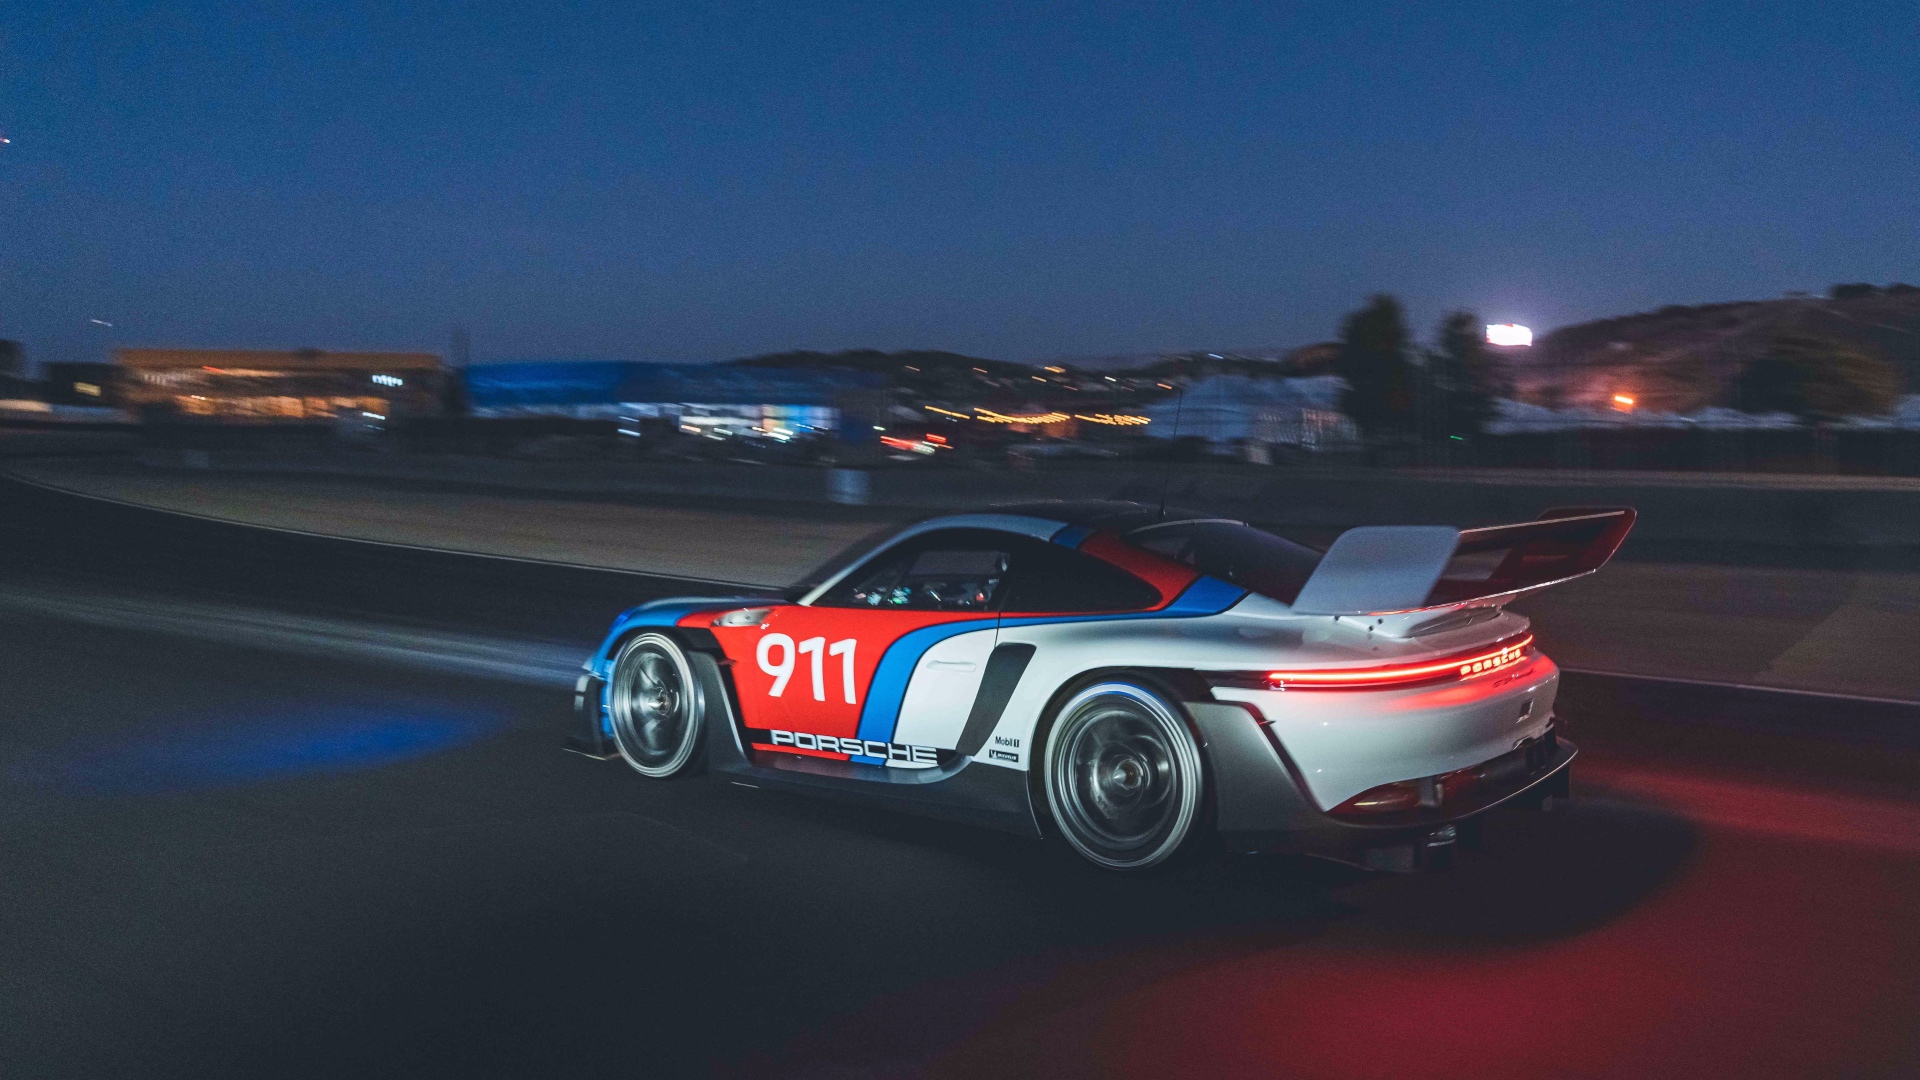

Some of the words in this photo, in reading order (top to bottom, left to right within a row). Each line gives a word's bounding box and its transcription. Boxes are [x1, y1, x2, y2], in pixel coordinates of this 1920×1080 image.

[756, 633, 857, 704] 911
[1460, 649, 1521, 675] PORSCHE
[770, 729, 938, 765] PORSCHE
[995, 735, 1013, 747] Mobil
